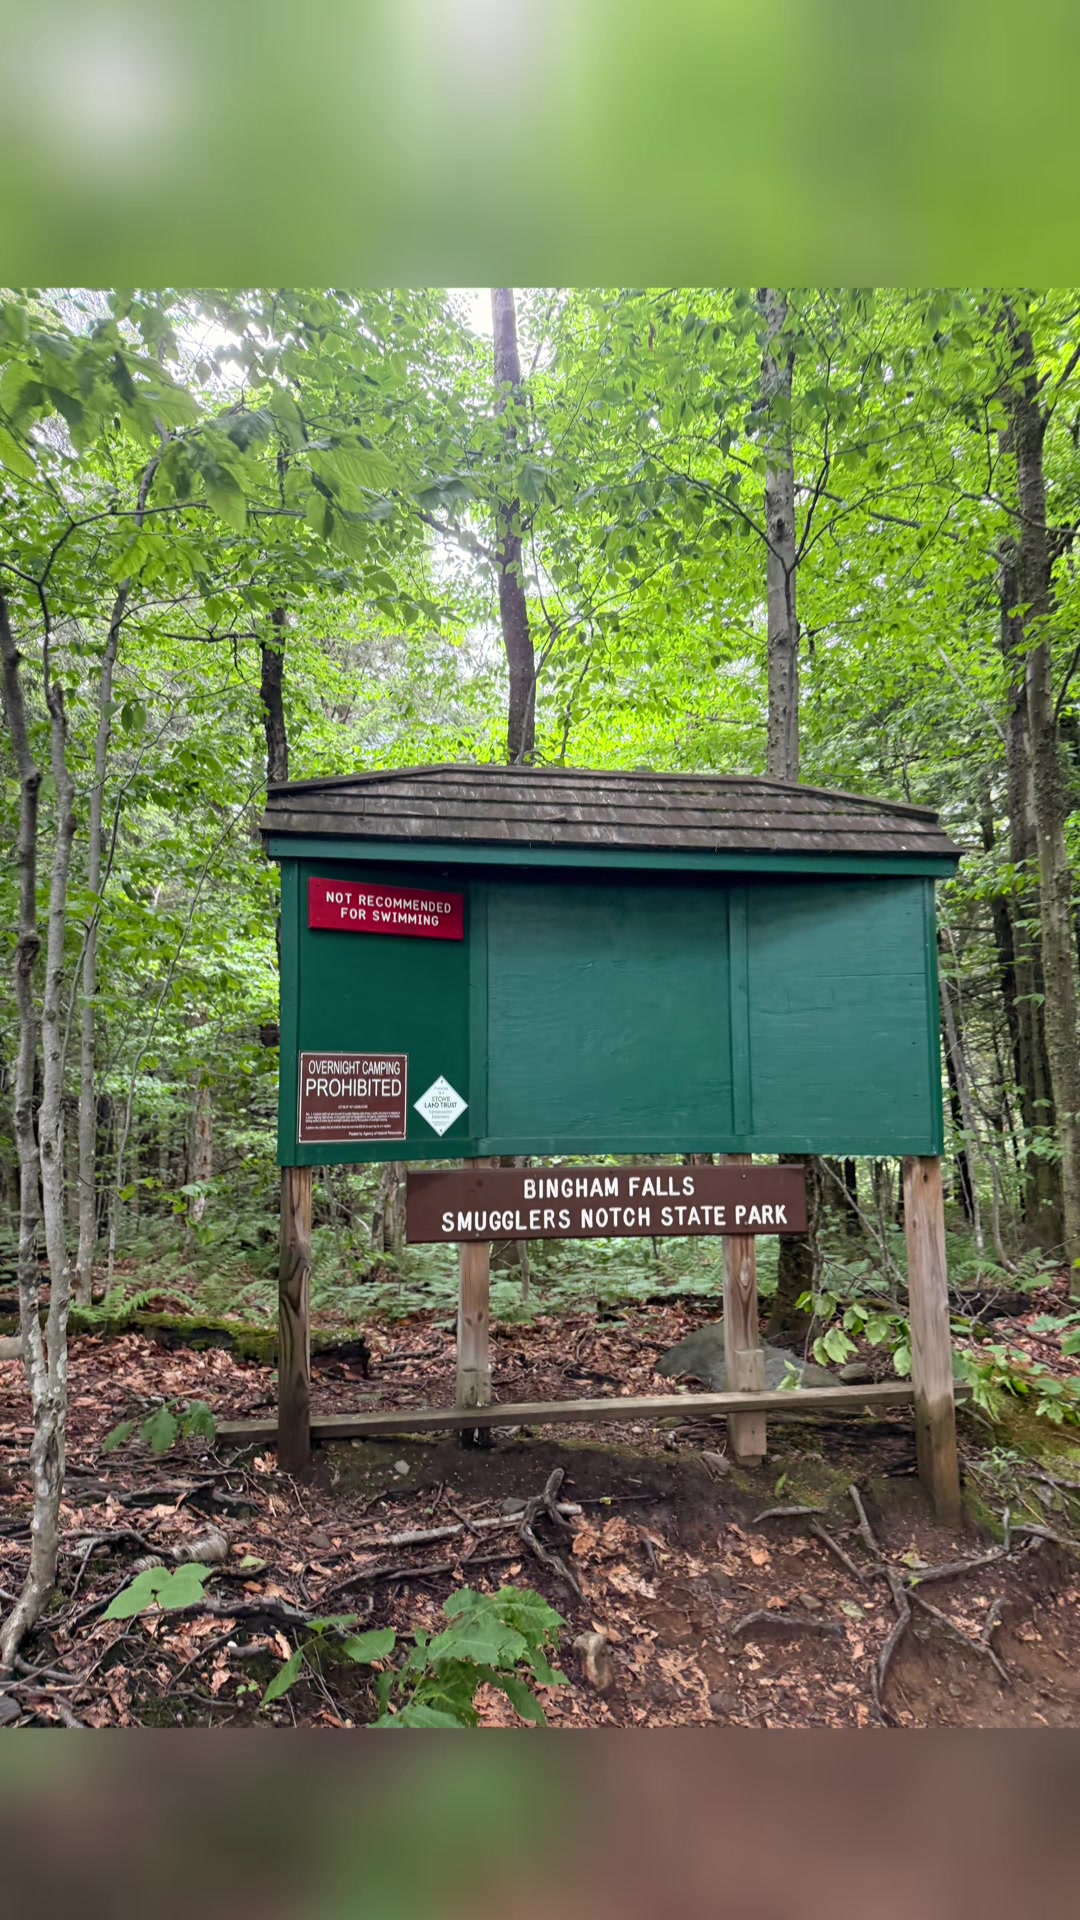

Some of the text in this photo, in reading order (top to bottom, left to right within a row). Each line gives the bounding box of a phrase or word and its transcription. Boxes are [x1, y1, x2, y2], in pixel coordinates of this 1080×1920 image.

[326, 891, 451, 914] NOT RECOMMENDED
[340, 907, 439, 927] FOR SWIMMING
[308, 1060, 400, 1075] OVERNIGHT CAMPING
[306, 1078, 402, 1097] PROHIBITED
[524, 1175, 695, 1200] BINGHAM FALLS
[441, 1204, 788, 1233] SMUGGLERS NOTCH STATE PARK
